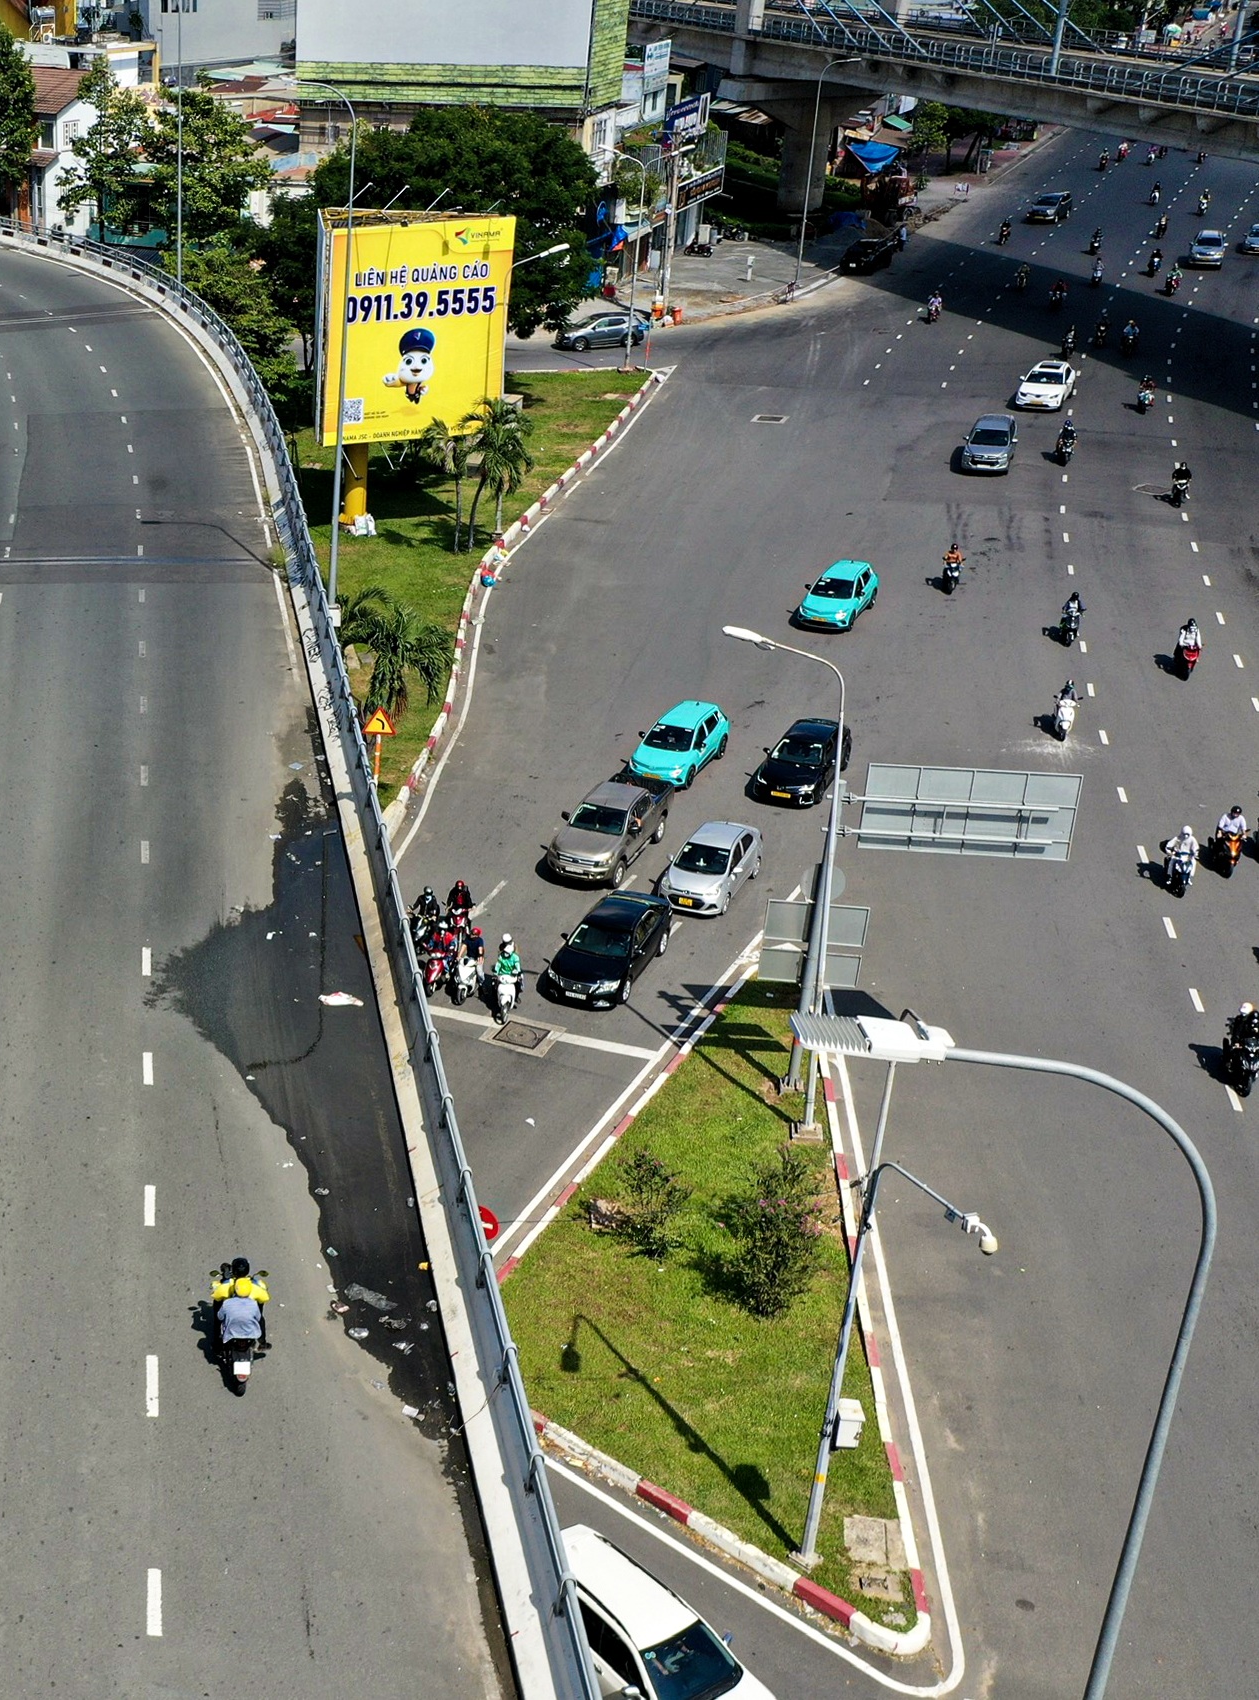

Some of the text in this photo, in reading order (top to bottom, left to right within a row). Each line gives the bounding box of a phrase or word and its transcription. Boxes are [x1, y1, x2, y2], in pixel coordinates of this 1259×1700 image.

[355, 260, 489, 288] LIÊN HỆ QUẢNG CÁO
[347, 286, 496, 323] 0911.39.5555
